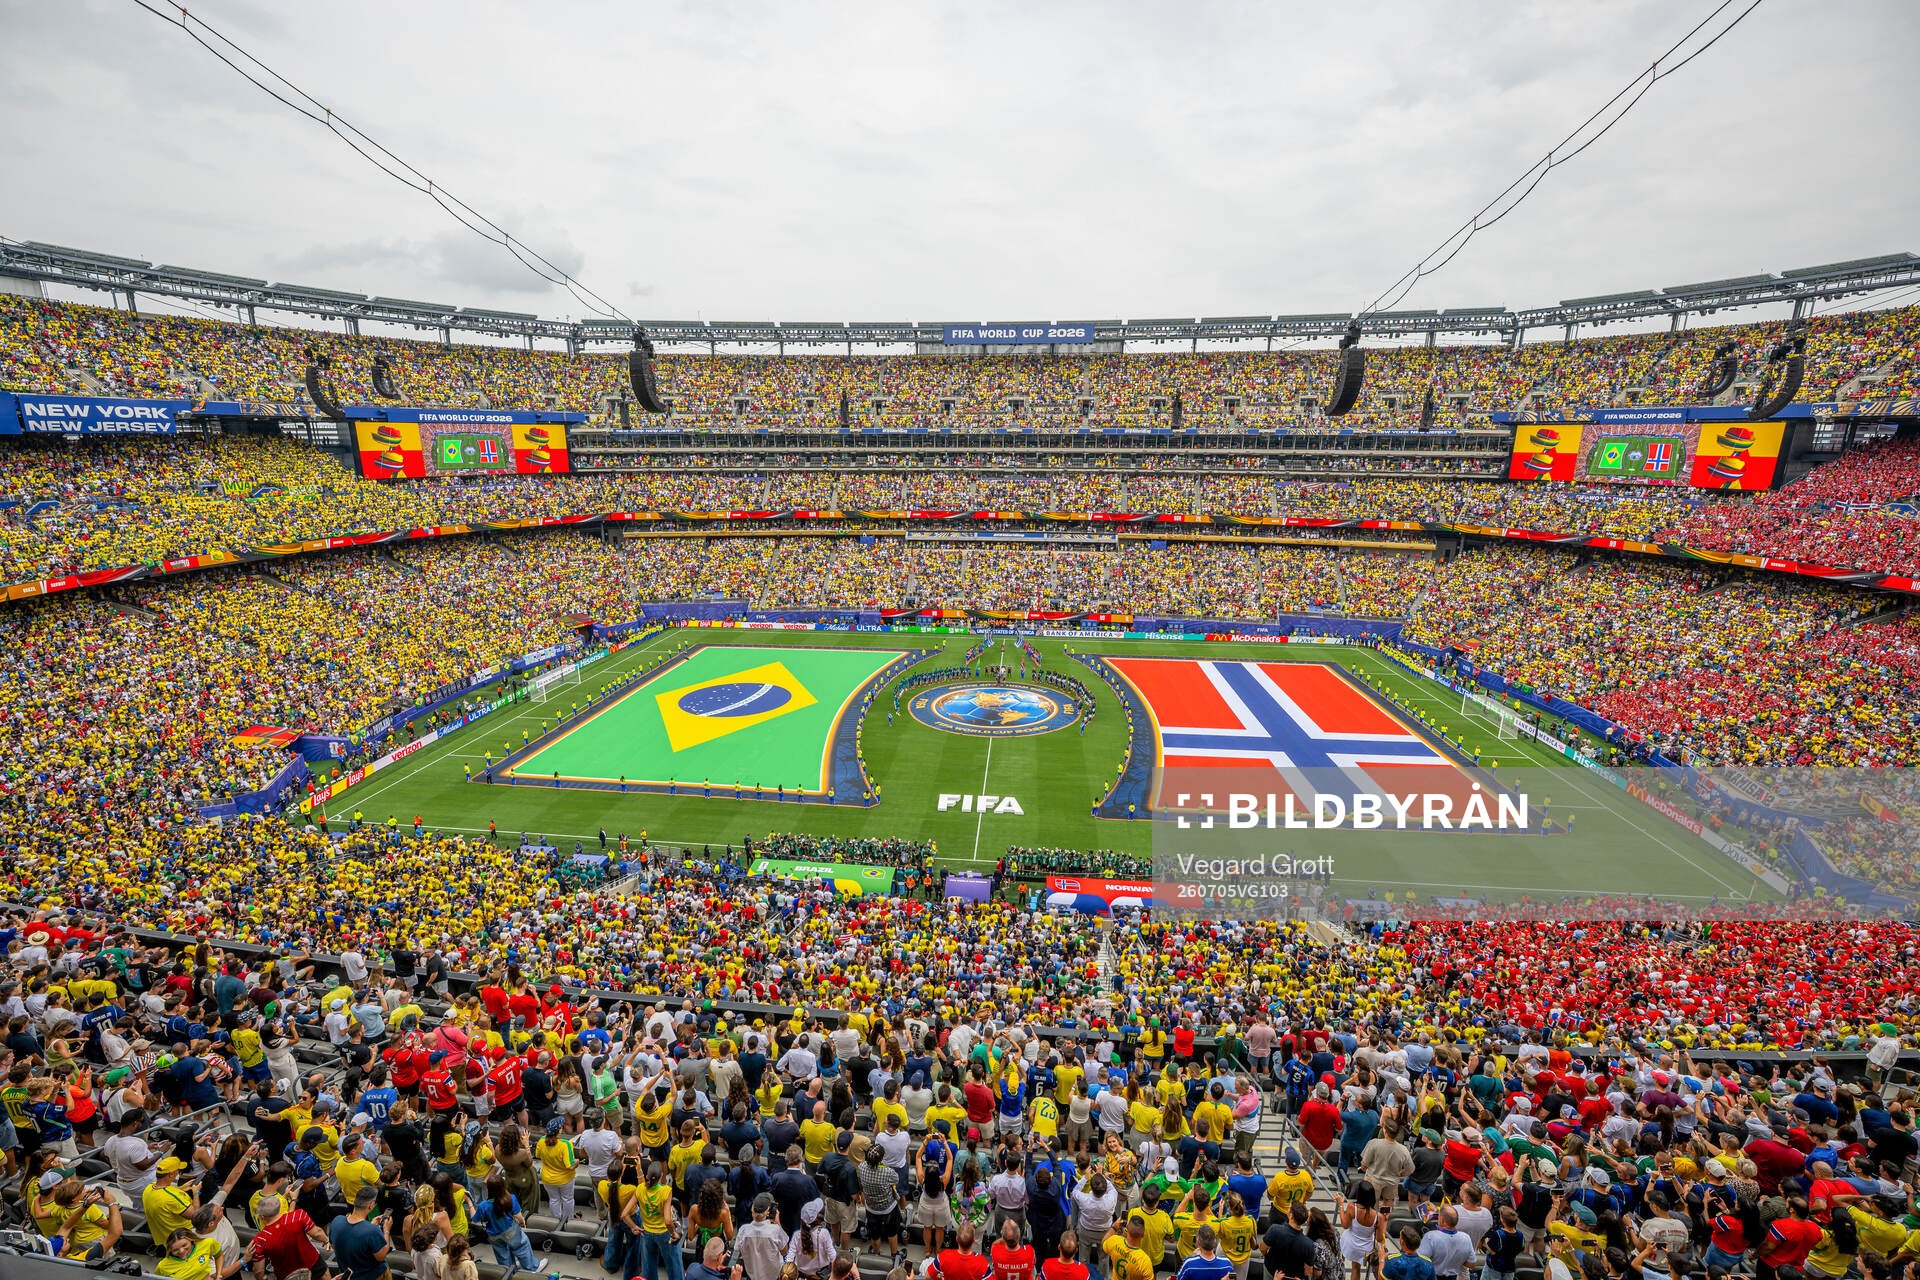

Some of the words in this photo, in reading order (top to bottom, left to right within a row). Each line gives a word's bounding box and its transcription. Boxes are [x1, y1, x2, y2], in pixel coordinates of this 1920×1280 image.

[952, 329, 975, 338] FIFA
[978, 329, 1016, 338] WORLD
[1022, 329, 1044, 338] CUP
[1047, 328, 1085, 338] 2026
[24, 403, 90, 417] NEW
[95, 405, 170, 419] YORK
[419, 413, 438, 421] FIFA
[470, 414, 485, 422] CUP
[28, 420, 82, 432] NEW
[88, 421, 171, 432] JERSEY
[1145, 632, 1184, 640] Hisense
[1231, 634, 1281, 643] McDonald's
[580, 652, 604, 667] Hisense
[438, 718, 463, 738] Michelob
[468, 705, 491, 722] ULTRA
[955, 726, 990, 734] WORLD
[391, 739, 423, 761] verizon
[1572, 751, 1617, 784] Hisense
[937, 793, 1025, 815] FIFA
[1645, 795, 1701, 835] McDonald's
[1721, 843, 1748, 864] Dove
[794, 866, 835, 874] BRAZIL
[1105, 884, 1156, 893] NORWAY
[96, 1018, 113, 1034] 10
[428, 1085, 439, 1099] 9
[1035, 1081, 1044, 1097] 6
[369, 1102, 387, 1119] 10
[1040, 1101, 1057, 1120] 23
[1286, 1188, 1303, 1203] 10
[1235, 1235, 1246, 1253] 9
[1115, 1258, 1128, 1280] 6
